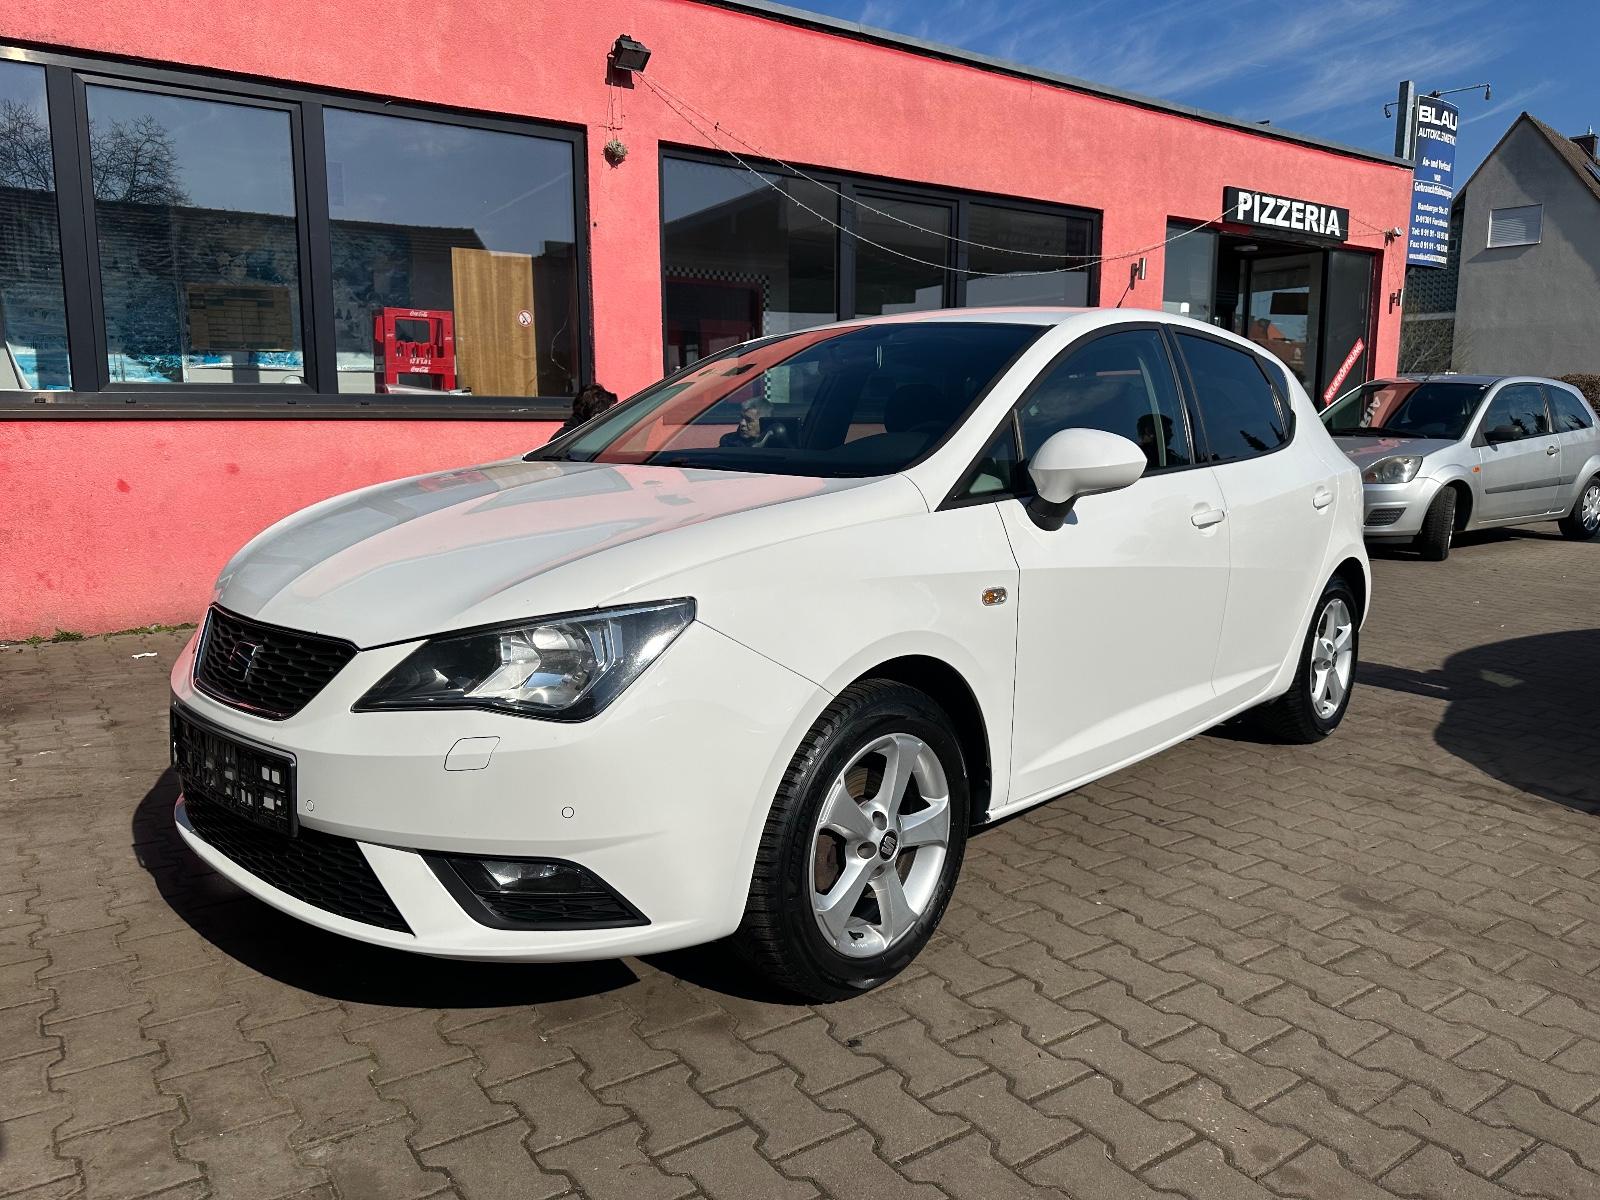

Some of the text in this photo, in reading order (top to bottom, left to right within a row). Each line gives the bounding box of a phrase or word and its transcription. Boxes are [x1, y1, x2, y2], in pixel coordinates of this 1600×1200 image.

[1419, 105, 1458, 131] BLAU
[1237, 191, 1341, 236] PIZZERIA
[1324, 341, 1362, 402] NEUERÖFFNUNG
